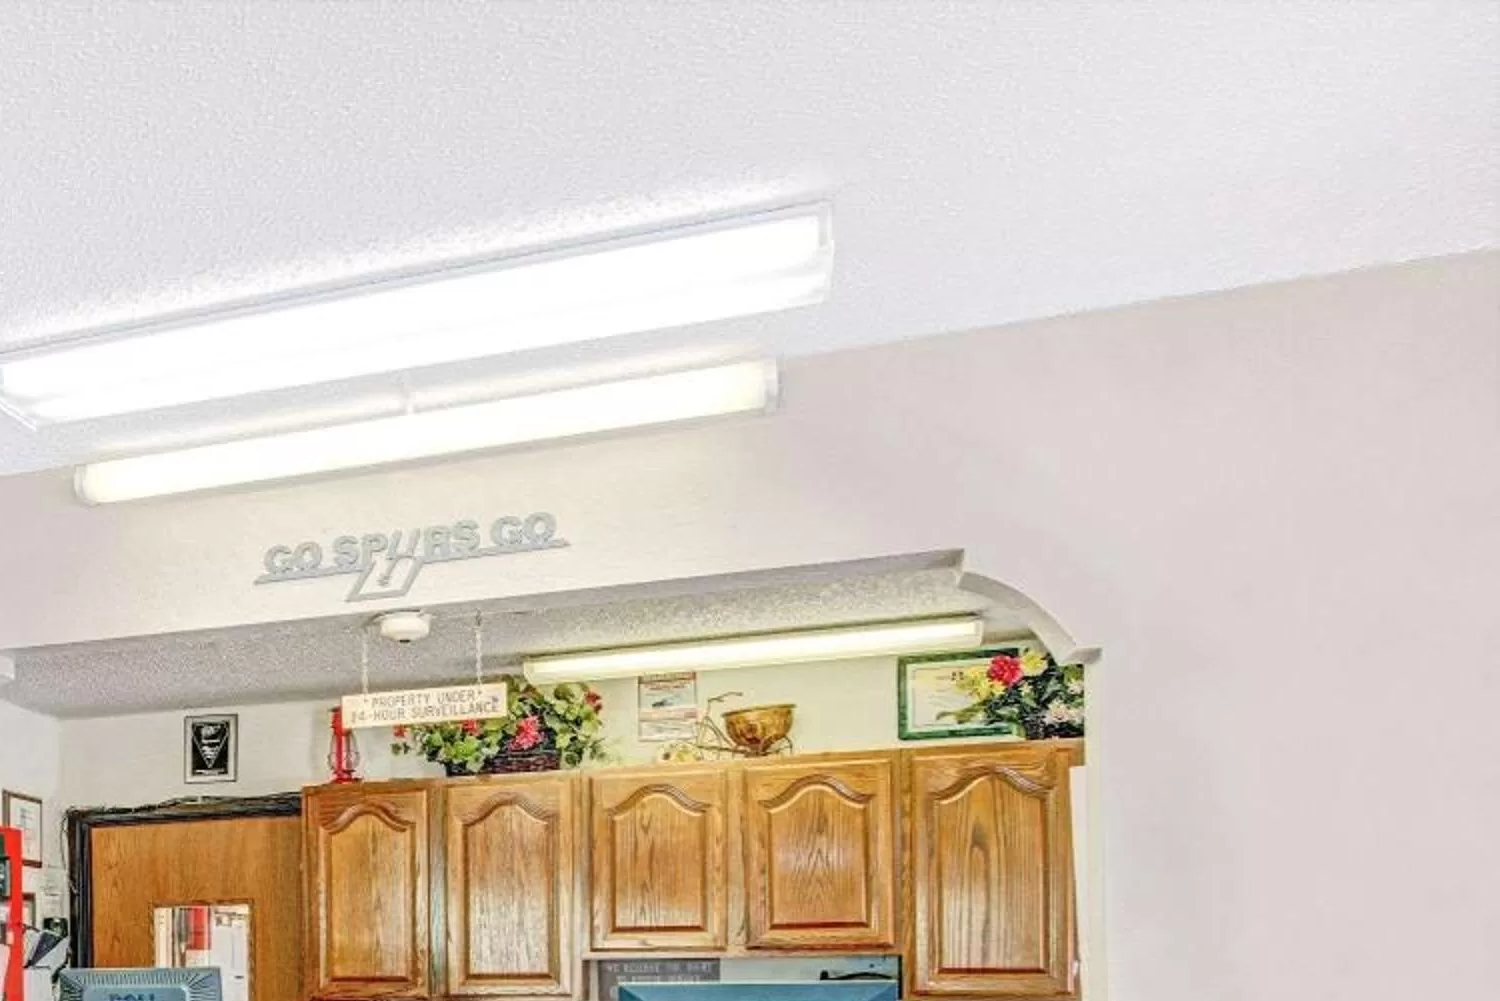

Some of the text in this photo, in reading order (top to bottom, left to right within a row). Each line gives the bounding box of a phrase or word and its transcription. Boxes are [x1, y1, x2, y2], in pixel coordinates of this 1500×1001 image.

[263, 540, 323, 575] GO
[490, 511, 557, 546] GO
[371, 689, 475, 709] PROPERTY UNDER
[411, 701, 500, 719] SURVEILLANCE
